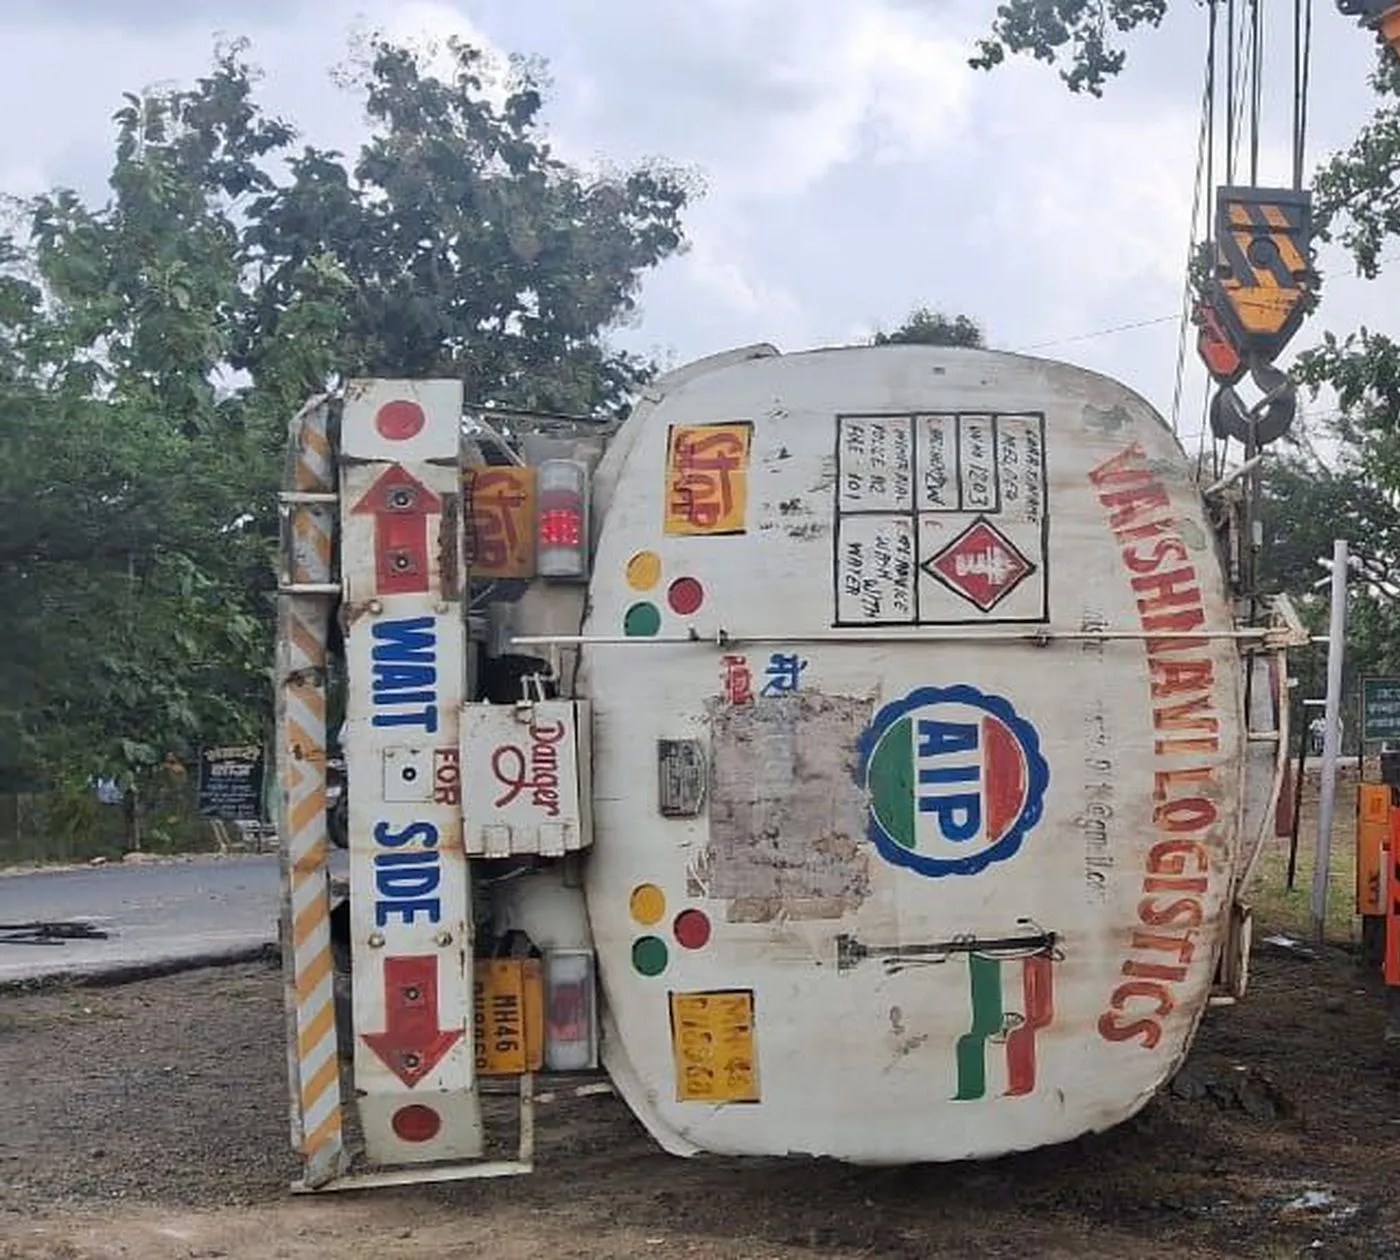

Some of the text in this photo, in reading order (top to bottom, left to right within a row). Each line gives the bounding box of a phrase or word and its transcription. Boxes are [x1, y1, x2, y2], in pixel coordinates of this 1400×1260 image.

[371, 616, 460, 927] WAIT FOR SIDE
[917, 719, 983, 843] AIP
[1088, 442, 1219, 1051] VAISHNAVI LOGISTICS
